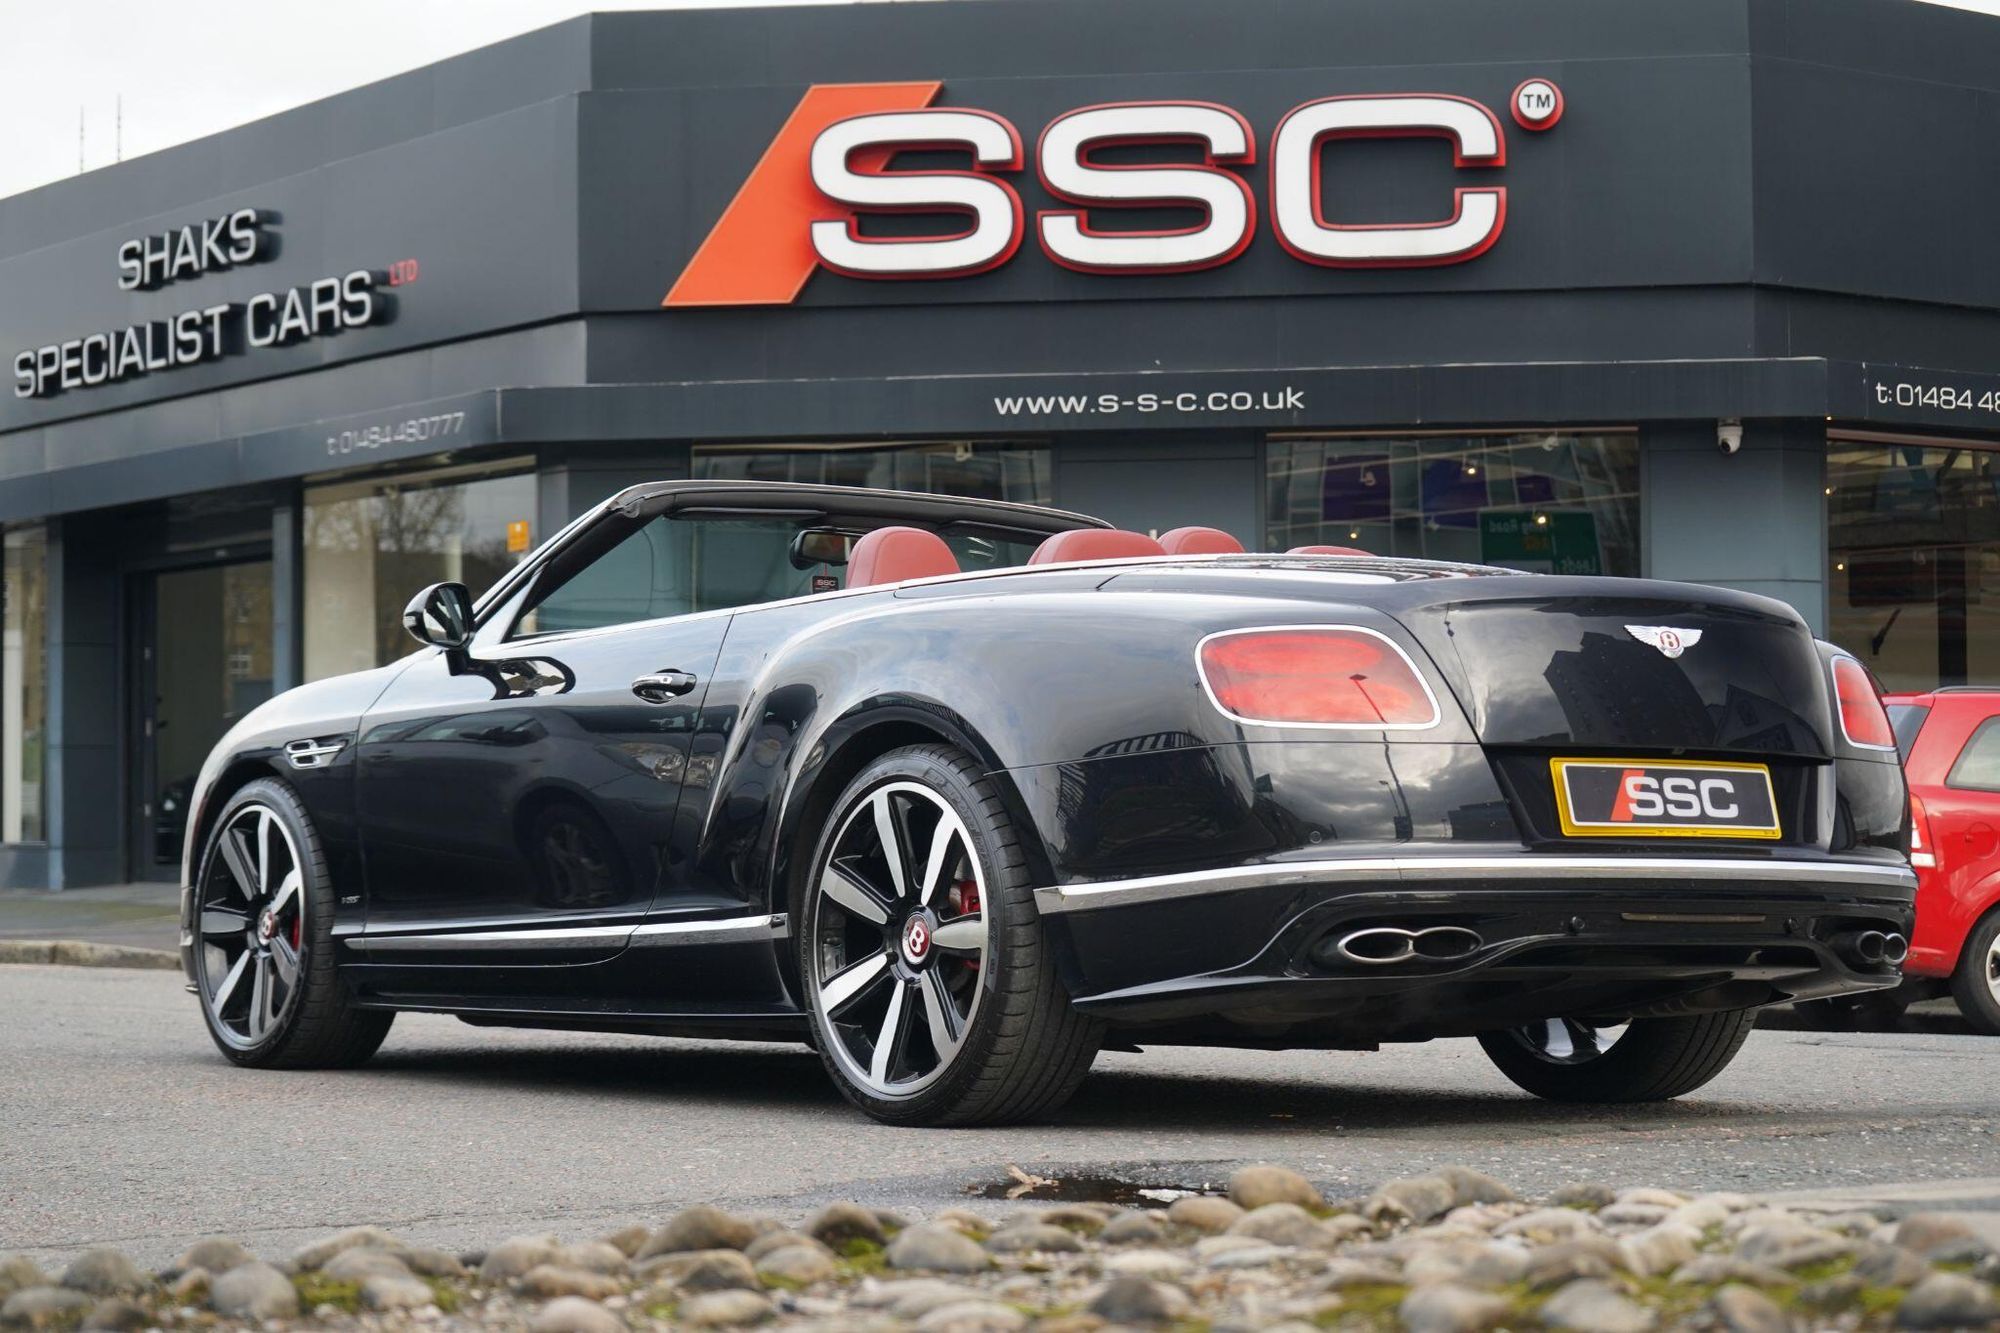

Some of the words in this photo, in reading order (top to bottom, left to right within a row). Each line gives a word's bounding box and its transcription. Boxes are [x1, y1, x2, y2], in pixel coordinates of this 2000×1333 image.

[811, 94, 1505, 278] SSC
[1523, 94, 1551, 108] TM
[117, 208, 258, 290] SHAKS
[14, 304, 230, 398] SPECIALIST
[246, 270, 372, 347] CARS
[389, 259, 417, 287] LTD
[994, 387, 1305, 415] www.s-s-c.co.uk
[1625, 776, 1739, 818] SSC
